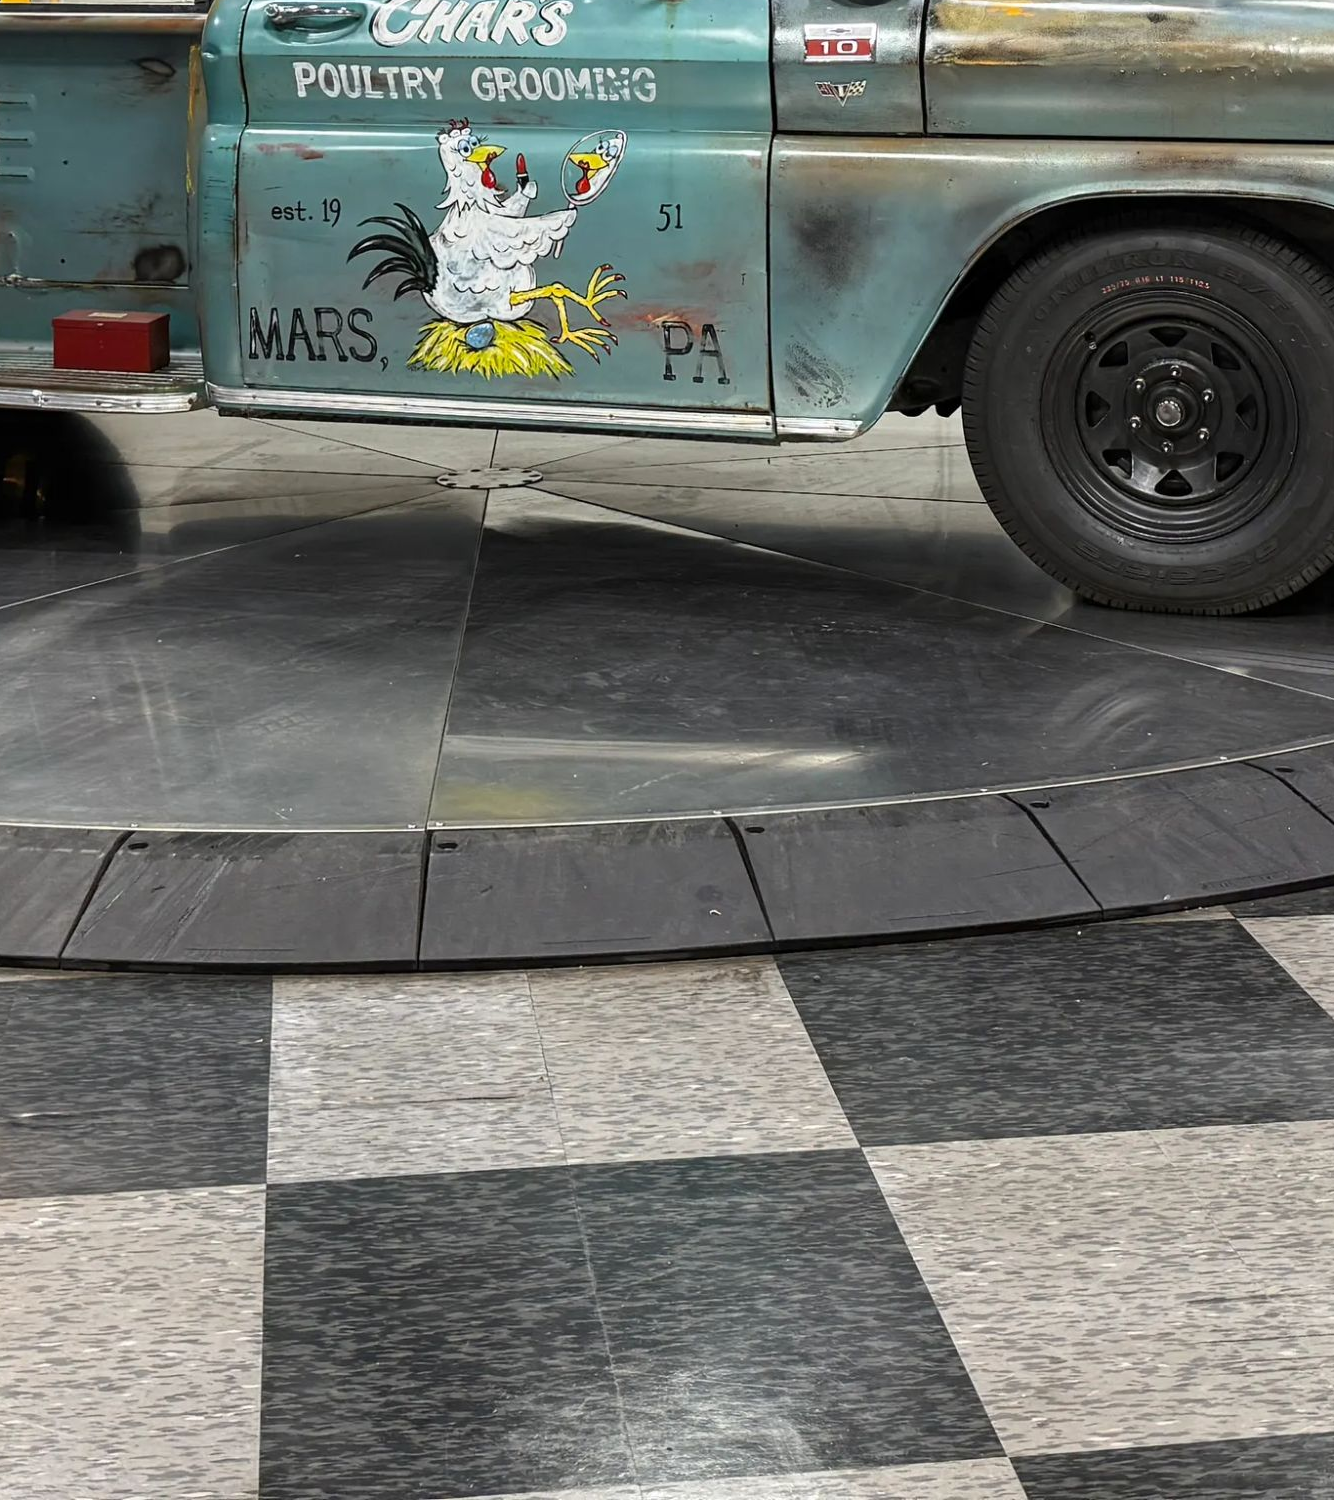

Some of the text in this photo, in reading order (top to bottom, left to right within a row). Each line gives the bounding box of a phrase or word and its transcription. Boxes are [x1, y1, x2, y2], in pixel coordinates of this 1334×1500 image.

[820, 40, 859, 55] 10
[292, 61, 658, 103] POULTRY GROOMING
[270, 198, 342, 228] est. 19
[656, 203, 684, 233] 51
[248, 306, 388, 372] MARS,
[661, 320, 731, 386] PA
